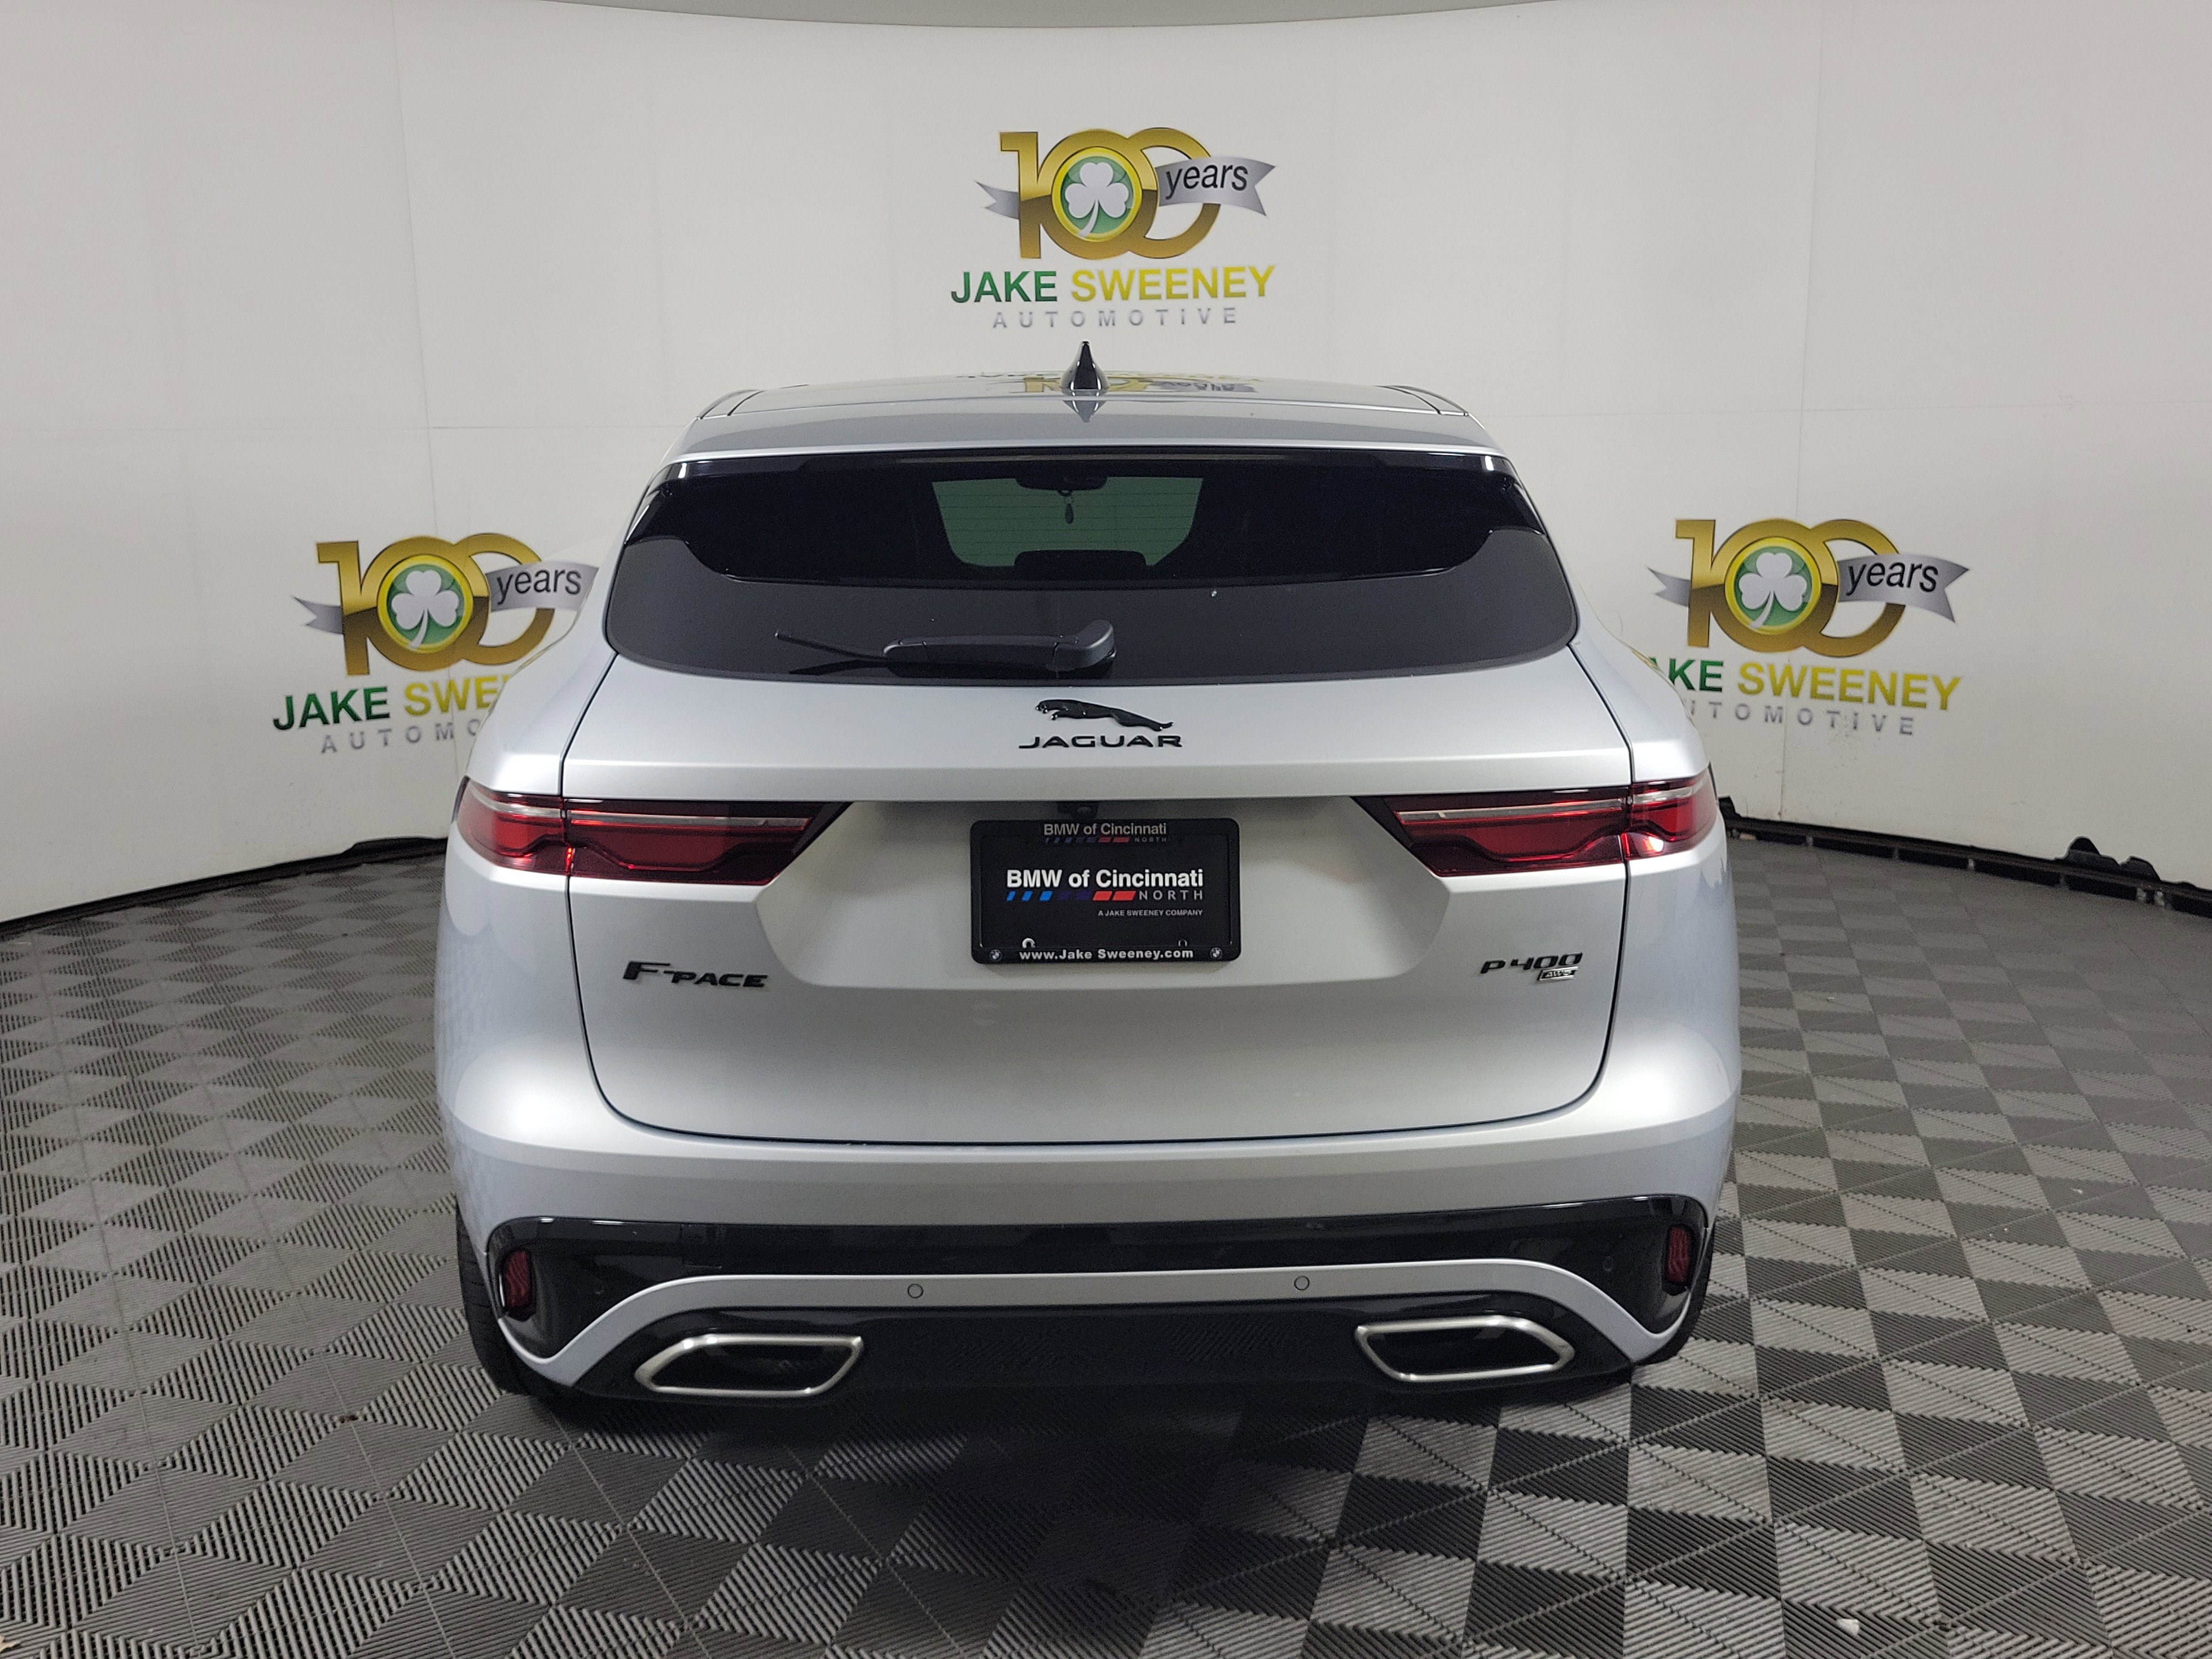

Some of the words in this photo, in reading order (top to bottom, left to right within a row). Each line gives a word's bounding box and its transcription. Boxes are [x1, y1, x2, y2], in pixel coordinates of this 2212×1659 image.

[999, 127, 1221, 260] 100
[1166, 163, 1248, 200] years
[951, 270, 1057, 303] JAKE
[1071, 266, 1275, 302] SWEENEY
[992, 307, 1237, 329] AUTOMOTIVE
[1675, 518, 1906, 658] 100
[1846, 561, 1939, 596] years
[317, 533, 555, 676] 100
[497, 568, 582, 605] years
[1648, 657, 1724, 693] KE
[1737, 662, 1961, 711] SWEENEY
[273, 686, 391, 731] JAKE
[404, 674, 510, 716] SWE
[1018, 735, 1183, 749] JAGUAR
[1043, 823, 1080, 835] BMW
[1083, 823, 1097, 835] of
[1100, 822, 1166, 835] Cincinnati
[1006, 869, 1062, 888] BMW
[1068, 869, 1090, 888] of
[1095, 868, 1204, 888] Cincinnati
[1138, 890, 1204, 901] NORTH
[1019, 949, 1093, 960] www.Jake
[1097, 949, 1194, 961] Sweeney.com
[1480, 952, 1583, 974] P400
[622, 961, 769, 988] F-PACE
